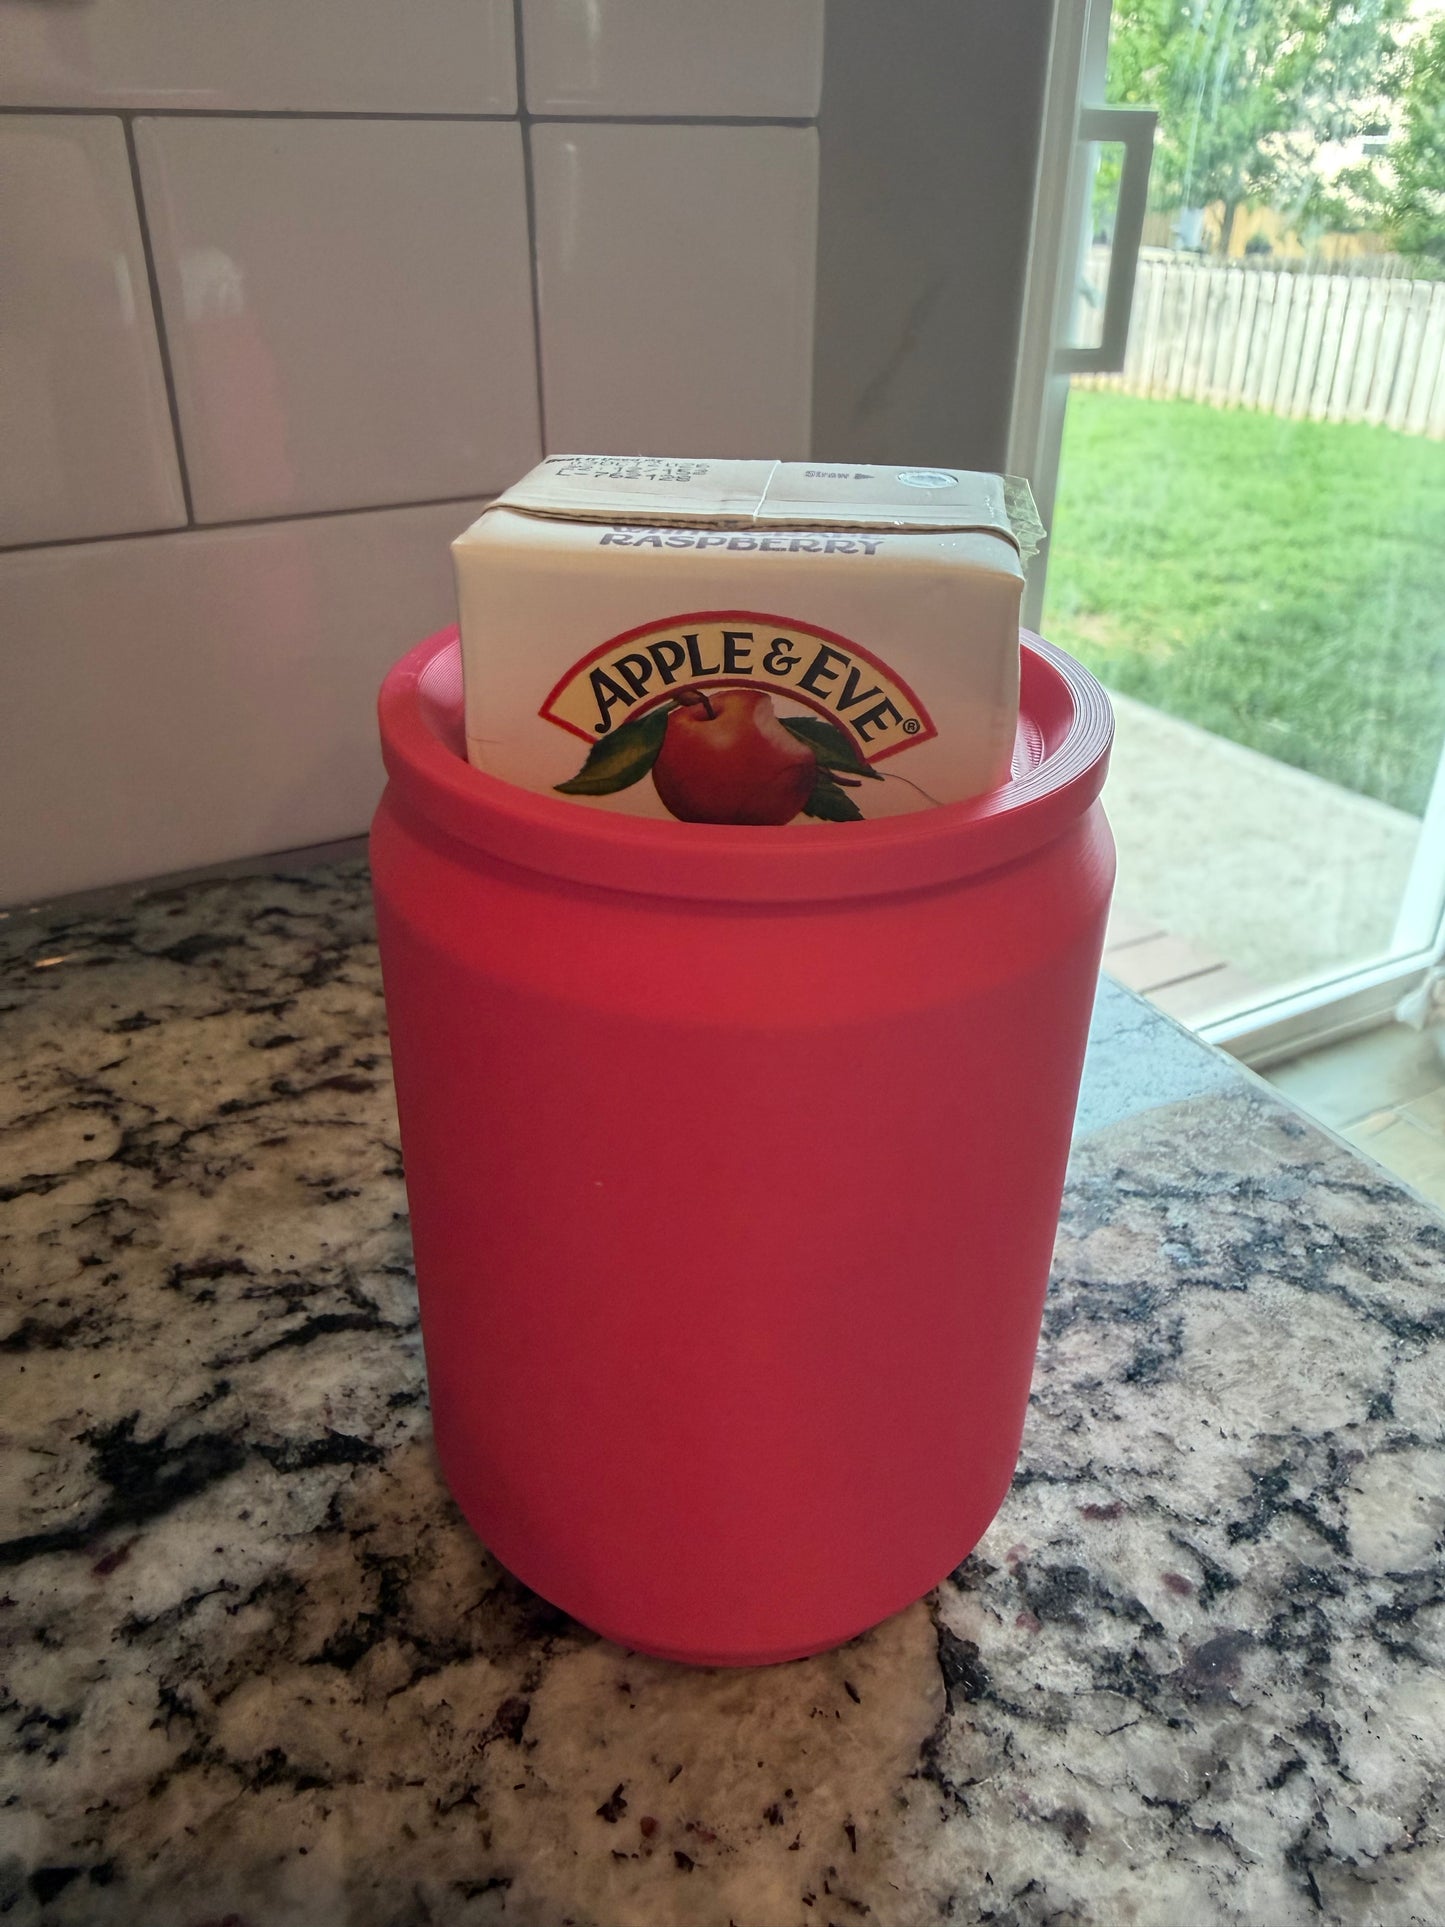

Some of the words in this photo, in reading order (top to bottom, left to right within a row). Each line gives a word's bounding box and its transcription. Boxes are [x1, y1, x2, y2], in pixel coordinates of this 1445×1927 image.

[600, 532, 884, 556] RASPBERRY
[588, 630, 755, 734] APPLE
[762, 637, 802, 676] &
